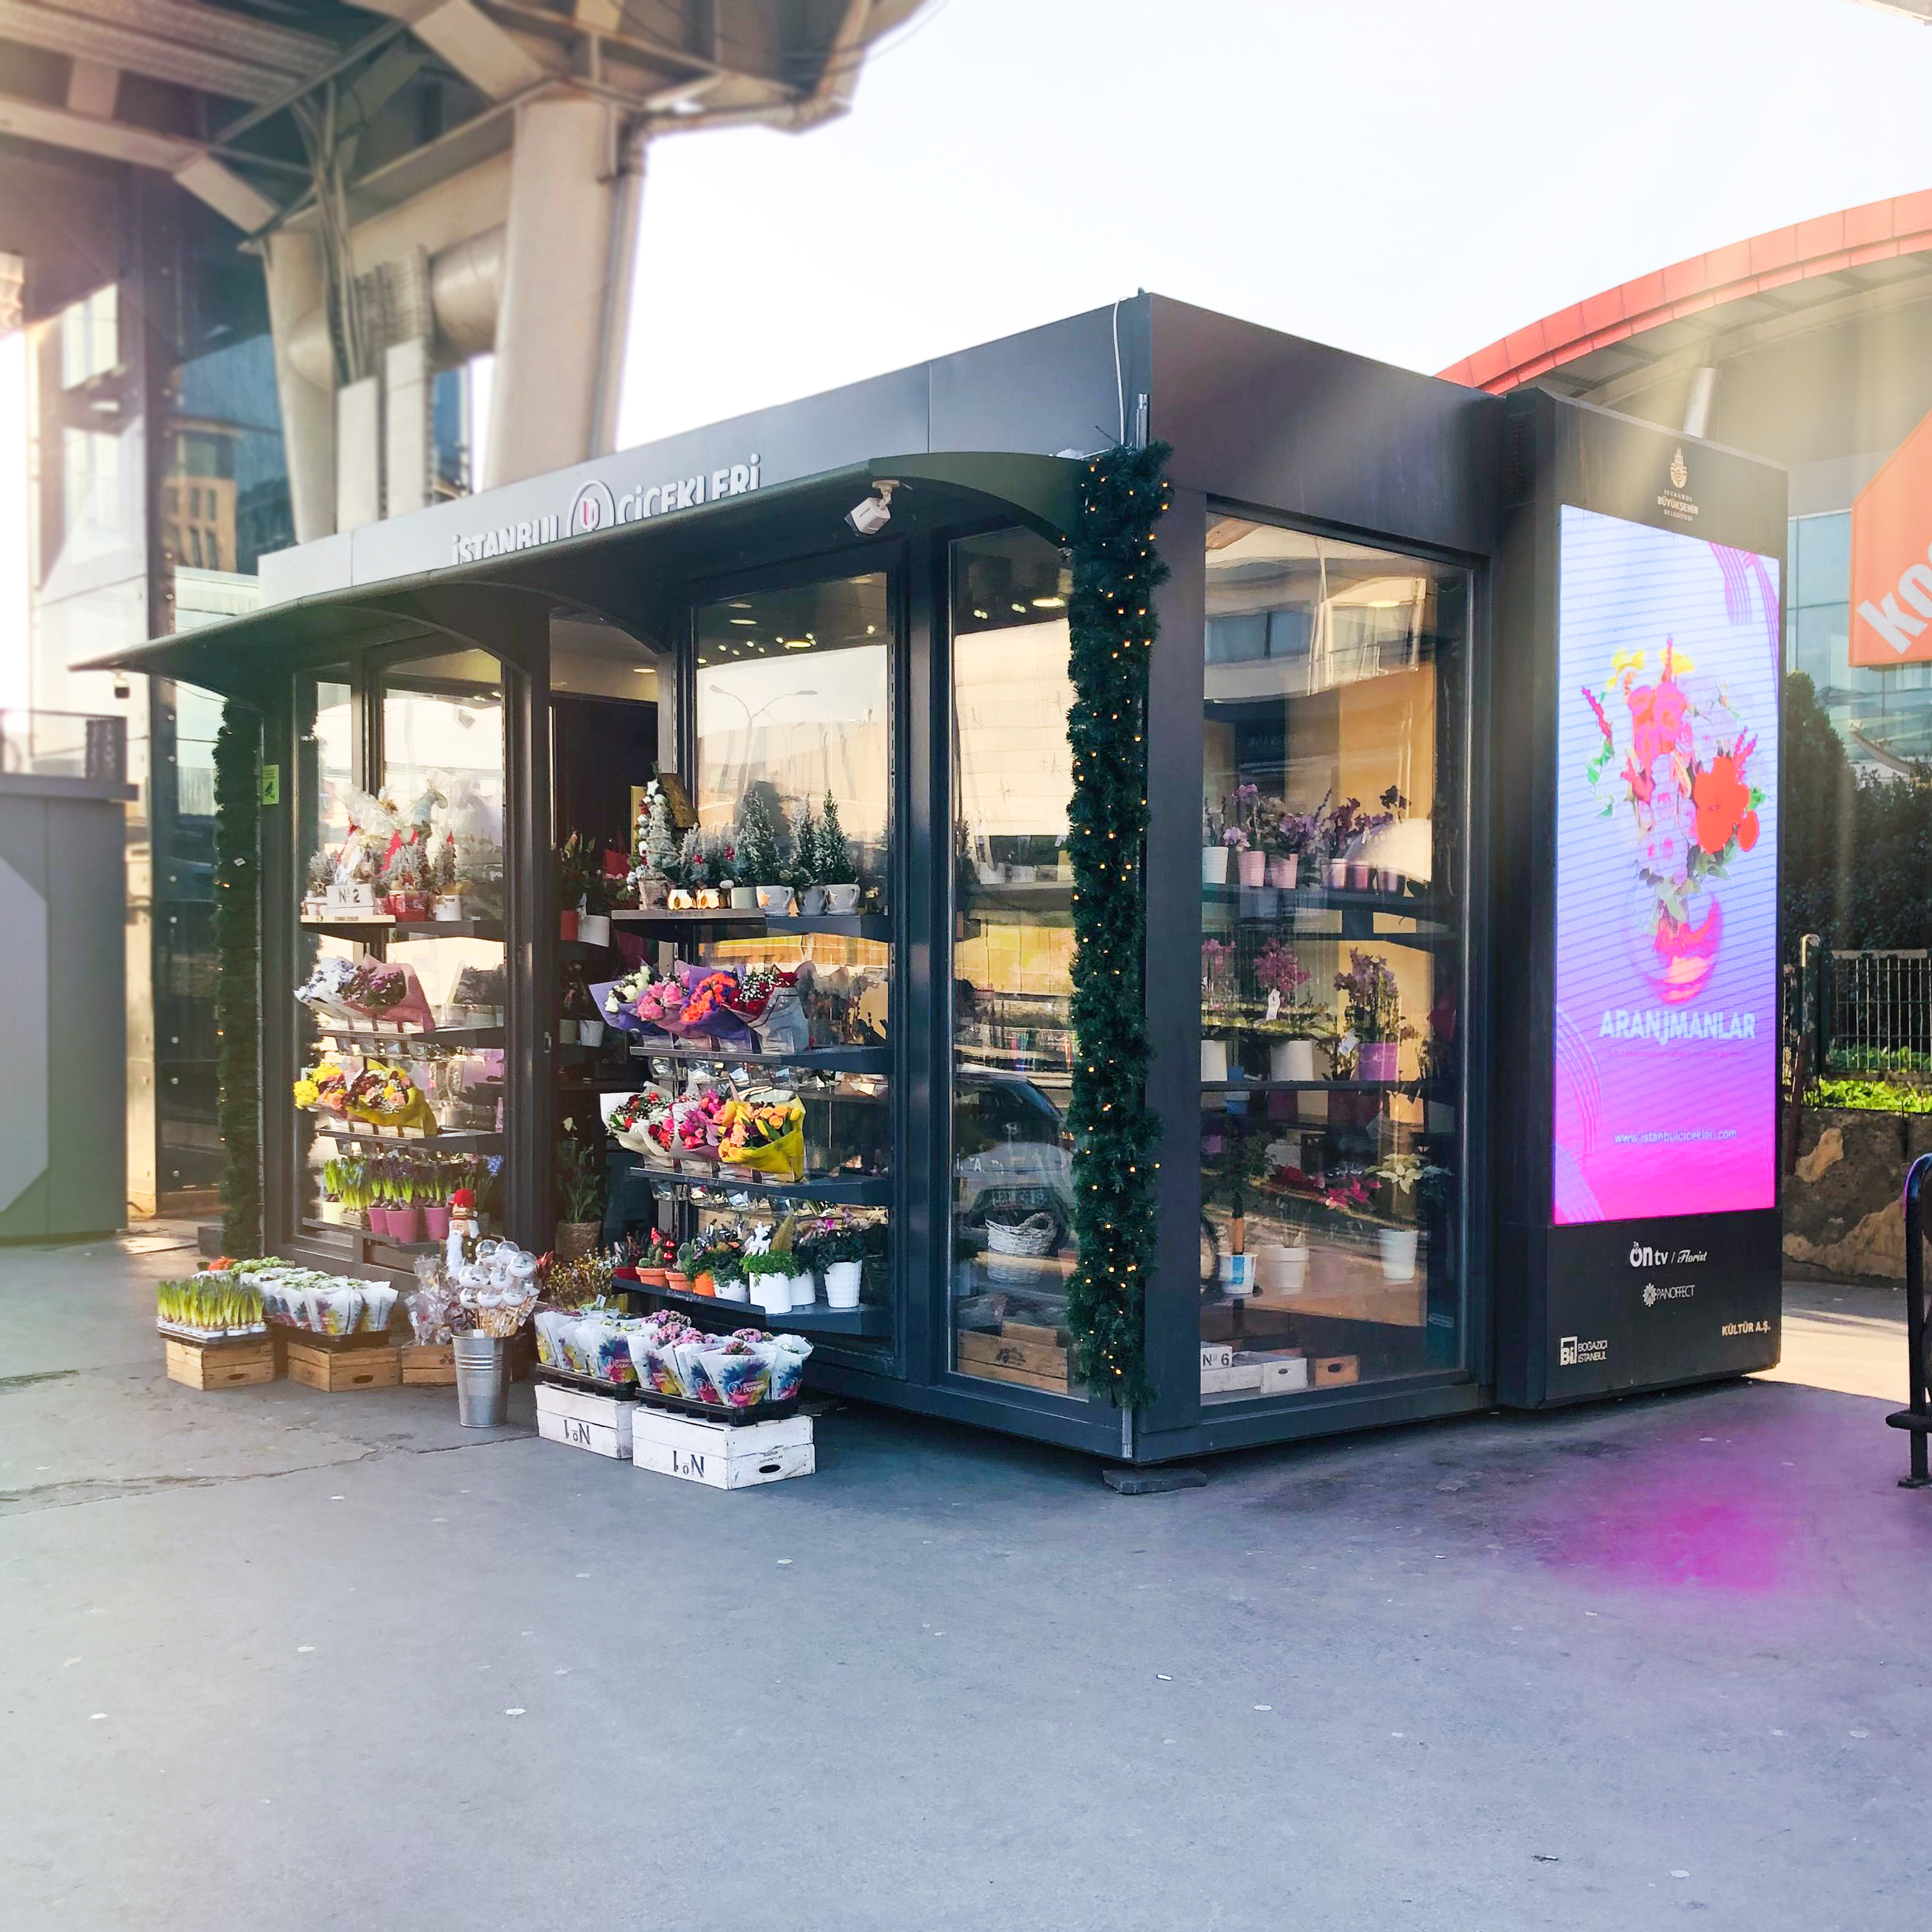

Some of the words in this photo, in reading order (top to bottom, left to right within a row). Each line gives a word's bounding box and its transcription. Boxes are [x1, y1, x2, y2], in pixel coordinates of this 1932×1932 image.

[1677, 1249, 1707, 1264] Florist
[1721, 1320, 1754, 1336] KÜLTÜR
[1221, 1353, 1229, 1366] 6
